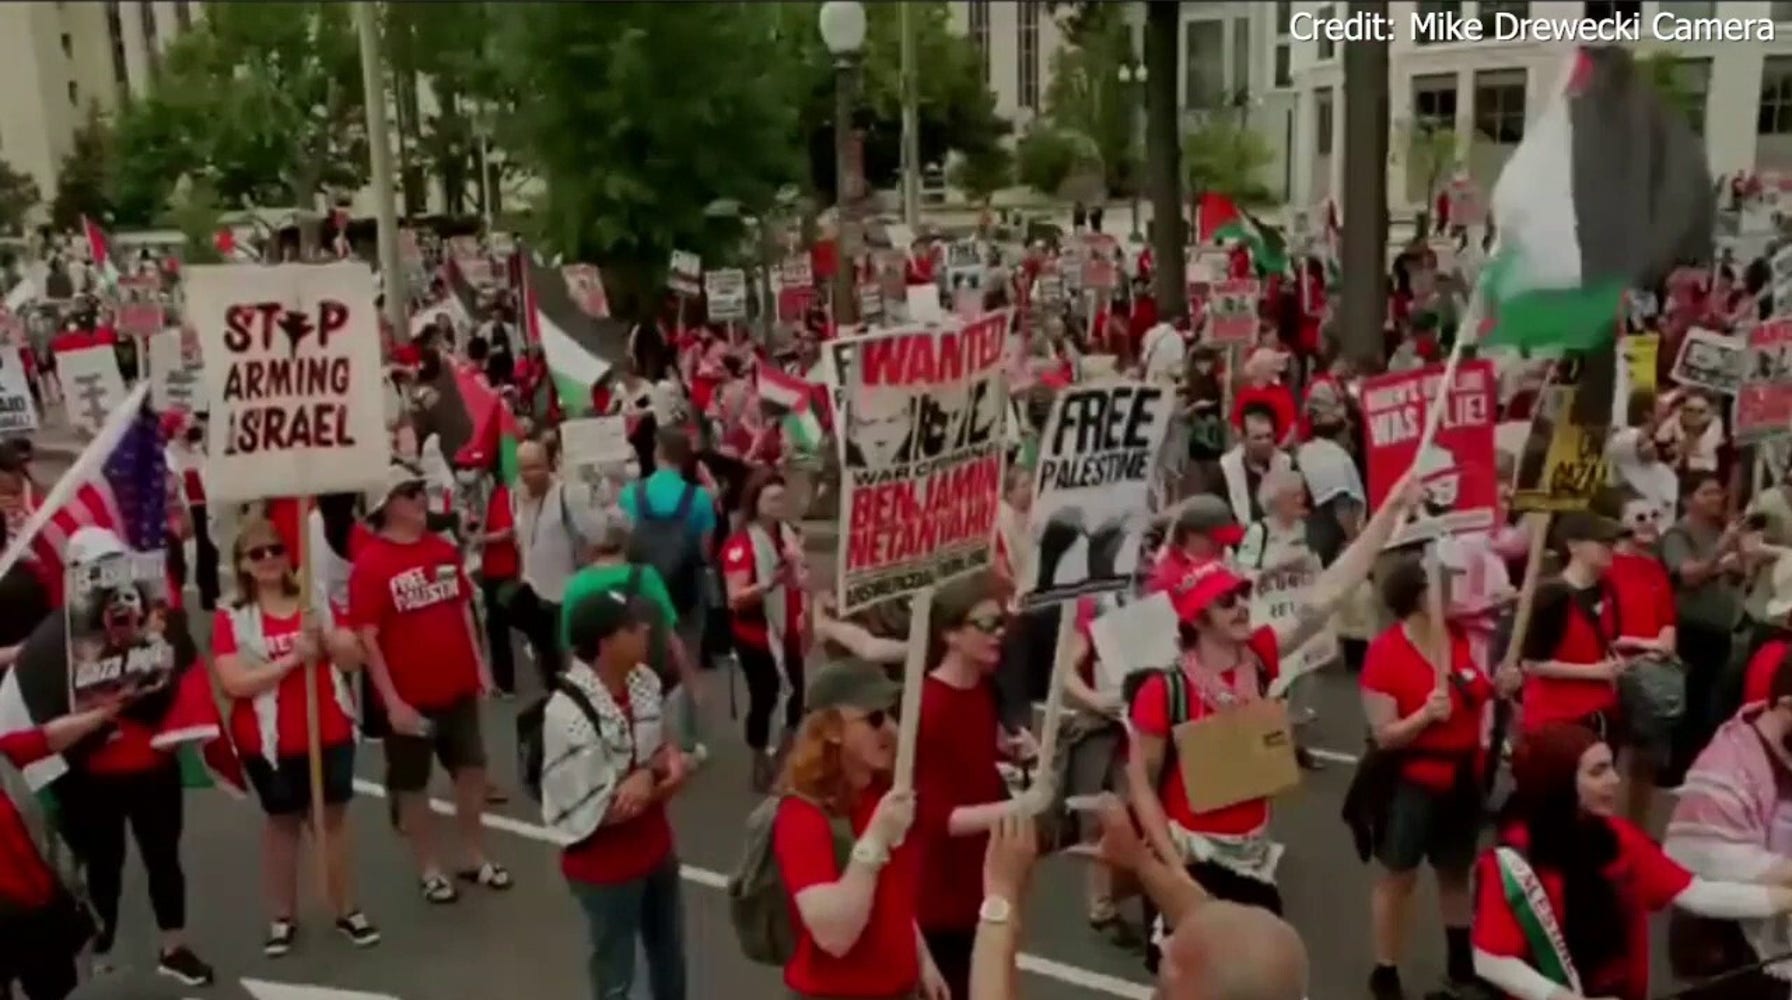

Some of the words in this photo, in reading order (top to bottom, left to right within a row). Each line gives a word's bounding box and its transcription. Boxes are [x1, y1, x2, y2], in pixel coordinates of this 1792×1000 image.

[223, 300, 350, 355] STP
[862, 314, 1008, 386] WANTED
[223, 356, 350, 403] ARMING
[223, 403, 357, 457] ISRAEL
[1051, 386, 1163, 457] FREE
[1370, 403, 1420, 447] WAS
[851, 465, 911, 487] WAR
[851, 454, 1000, 528] BENJAMIN
[1036, 450, 1151, 498] PALESTINE
[846, 498, 998, 573] NETANYAHU
